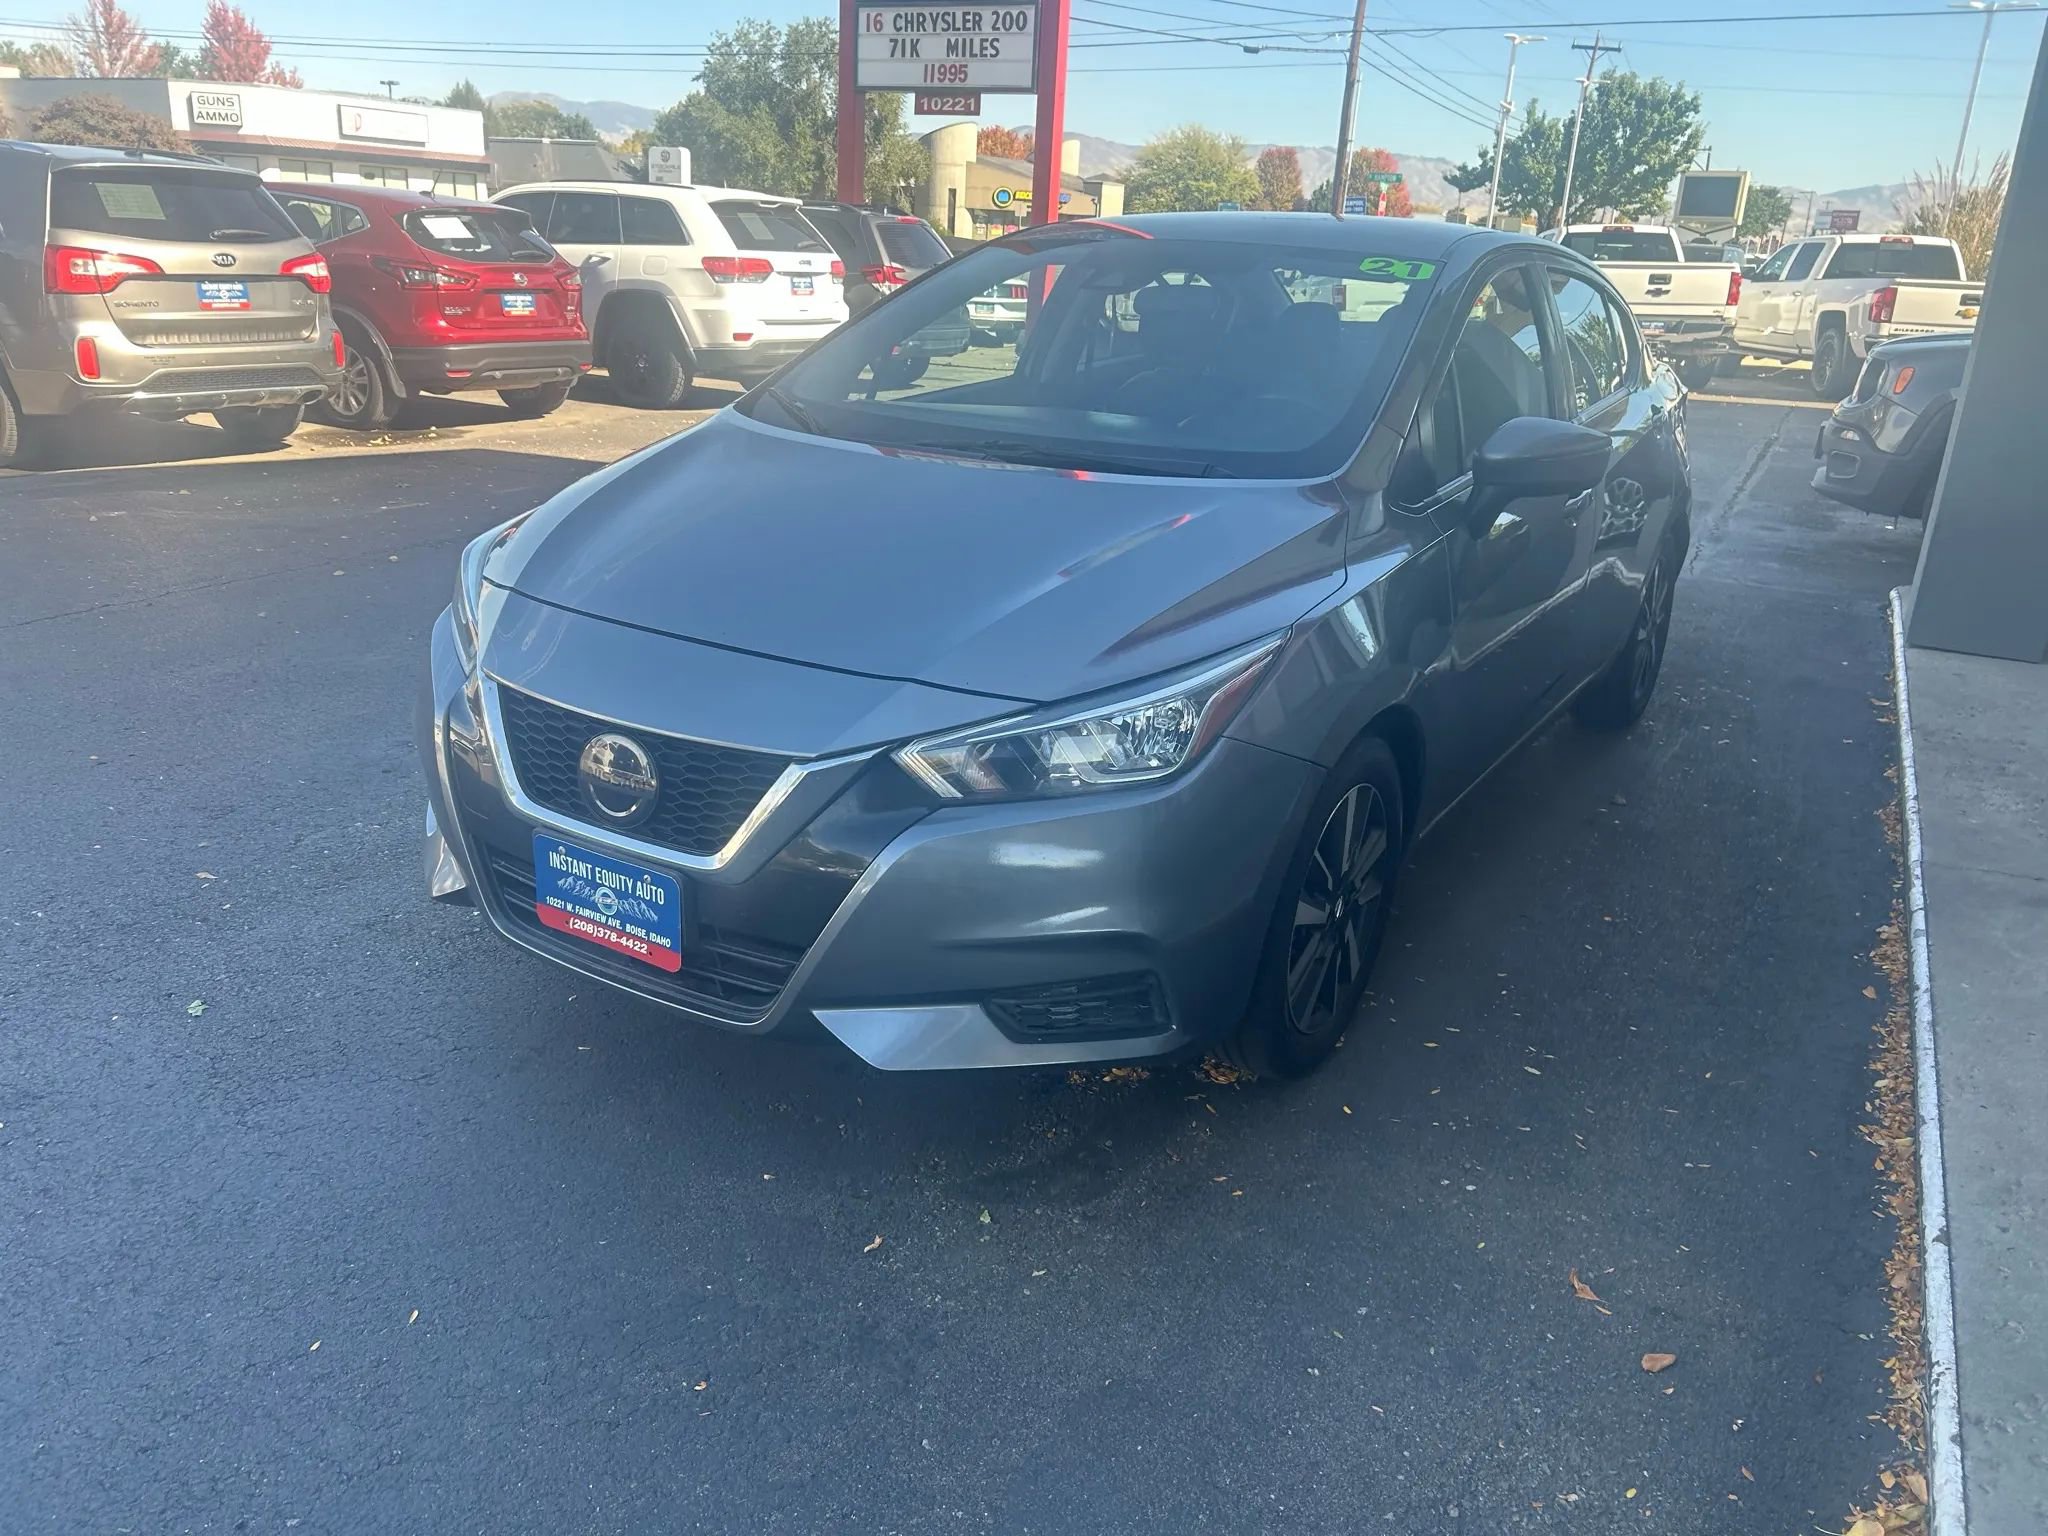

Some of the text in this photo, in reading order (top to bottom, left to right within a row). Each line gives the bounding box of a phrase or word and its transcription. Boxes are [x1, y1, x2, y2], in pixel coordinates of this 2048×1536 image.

[866, 10, 1028, 33] 16 CHRYSLER 200
[889, 38, 1000, 58] 71K MILES
[923, 63, 969, 84] 11995
[197, 95, 235, 107] GUNS
[920, 97, 976, 112] 10221
[196, 110, 239, 123] AMMO
[215, 254, 236, 265] KIA
[1365, 259, 1423, 278] 21
[549, 851, 665, 905] INSTANT EQUITY AUTO
[546, 895, 671, 948] 10221 W. FAIRVIEW AVE. BOISE, IDAHO
[569, 917, 648, 954] (208)378-4422
